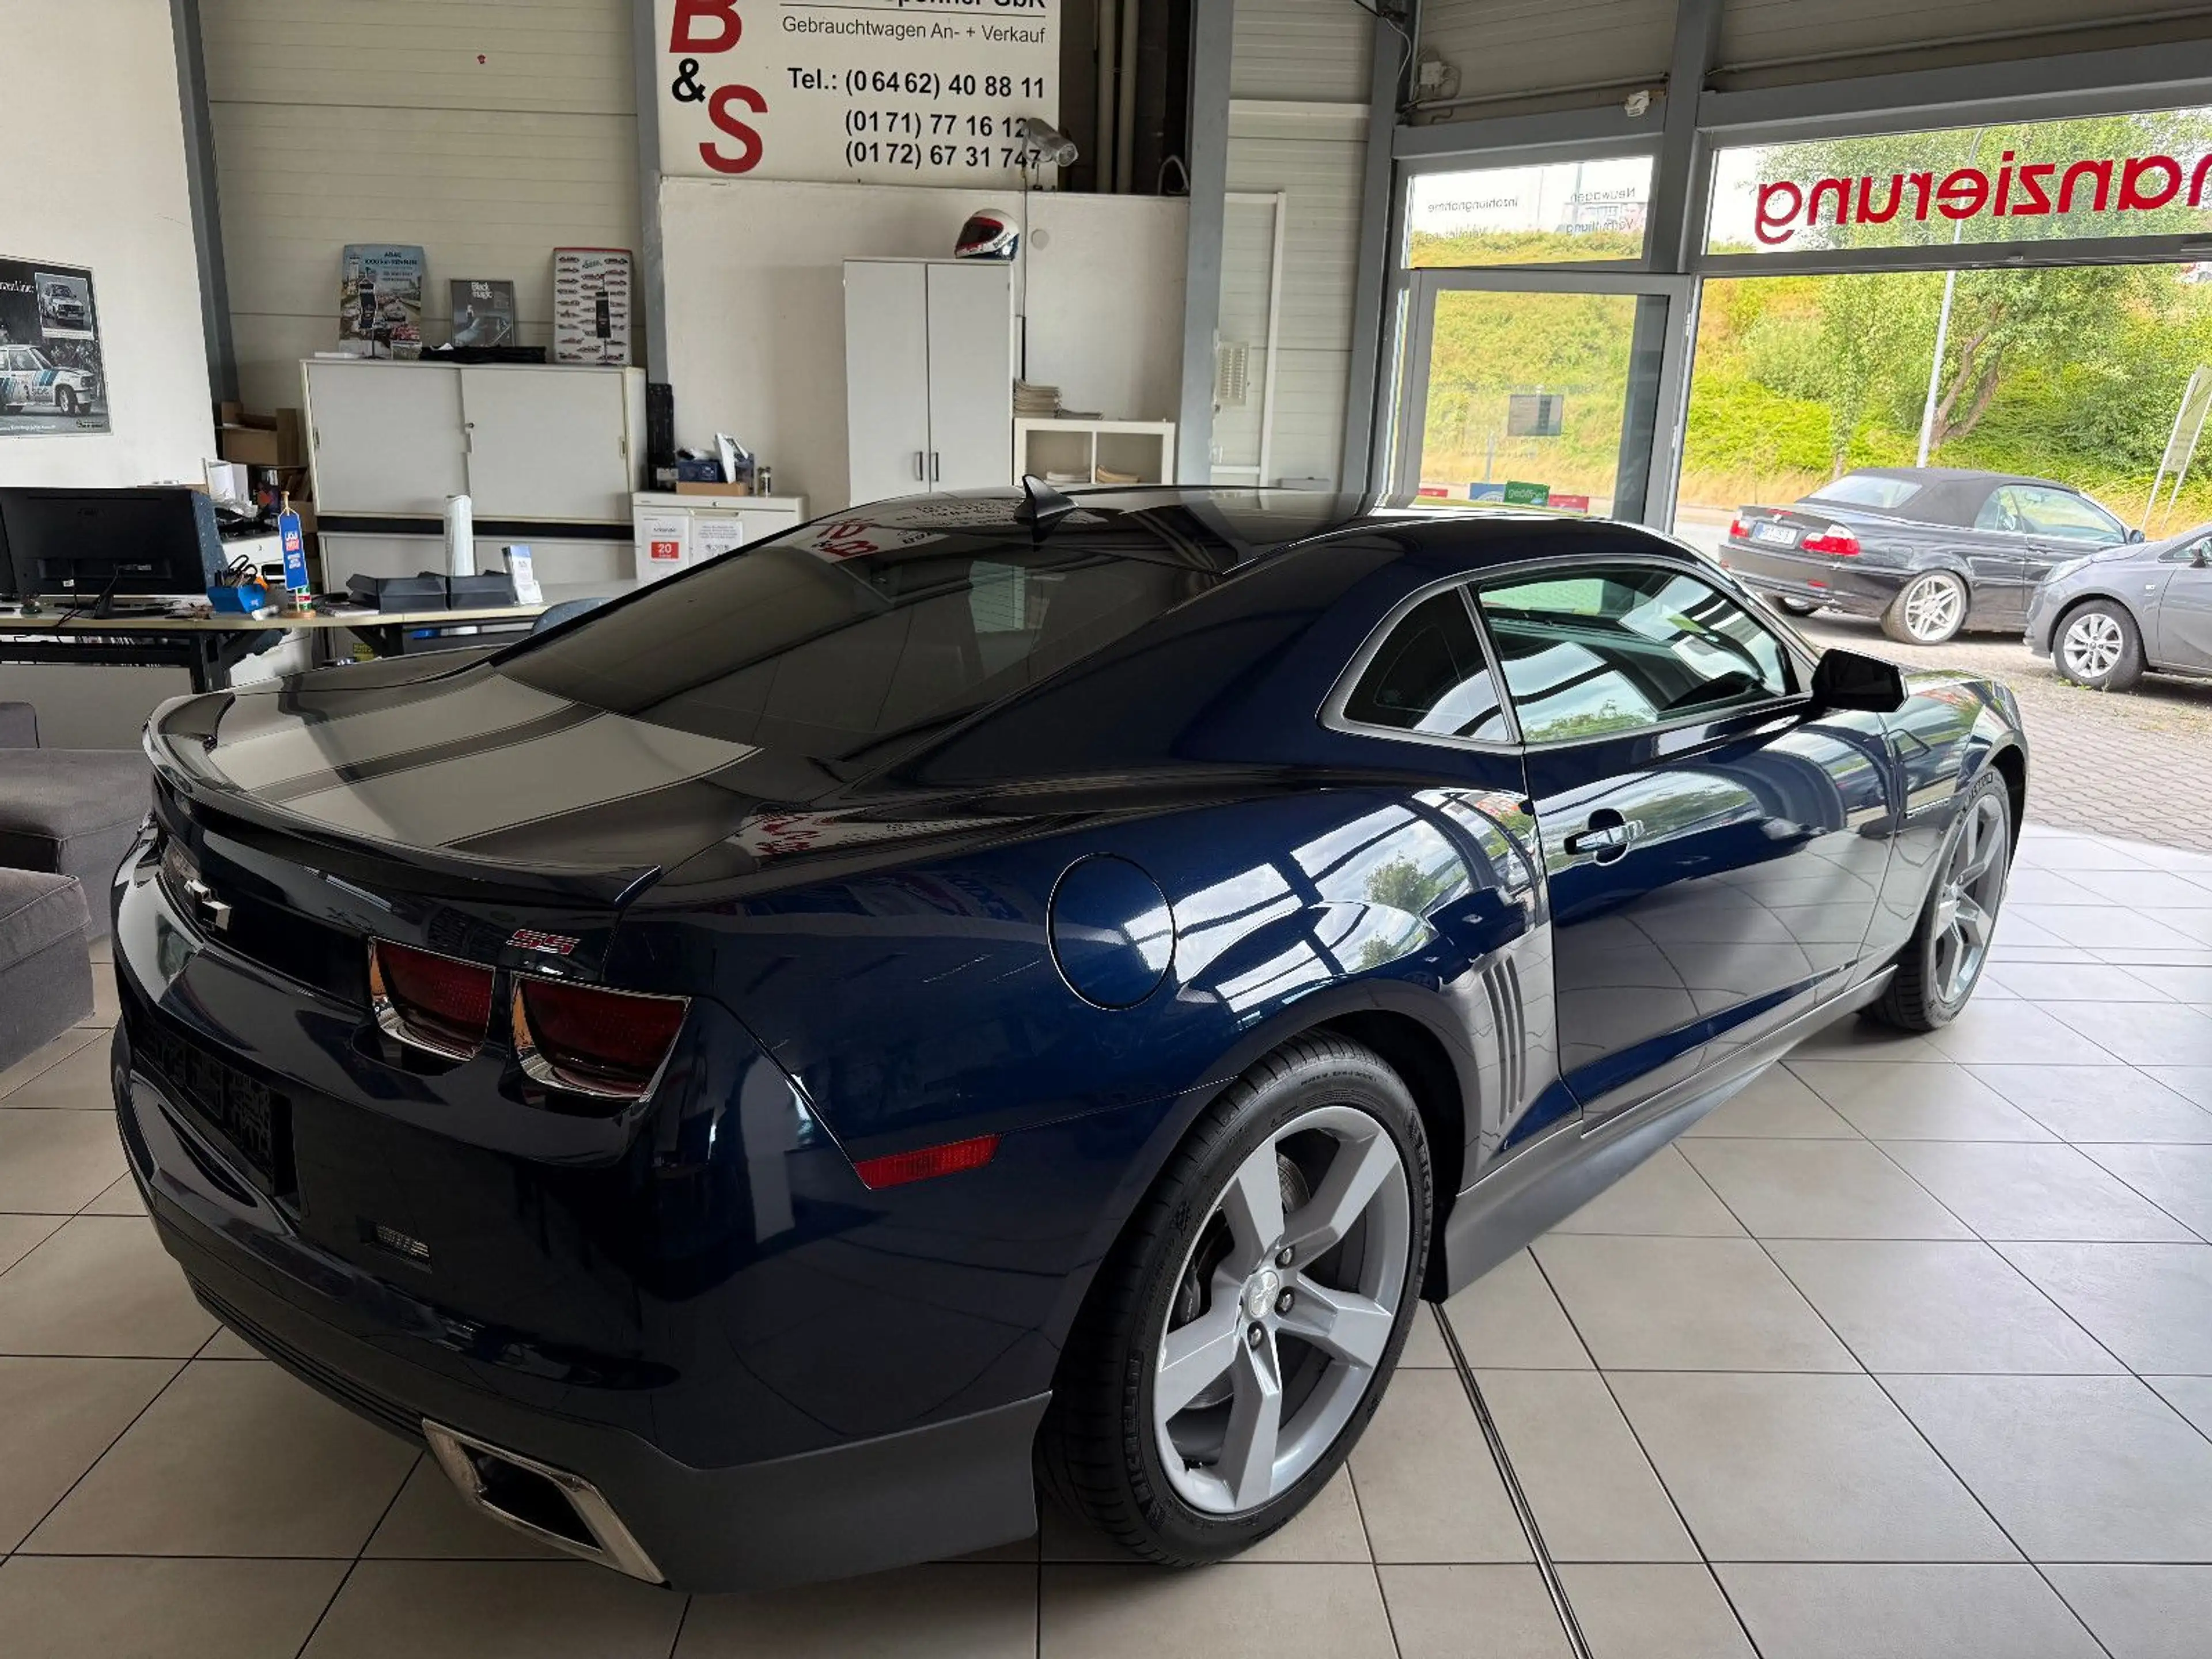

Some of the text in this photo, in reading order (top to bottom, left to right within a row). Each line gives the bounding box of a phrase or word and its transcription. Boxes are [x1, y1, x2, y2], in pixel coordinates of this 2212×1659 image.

[670, 0, 741, 53] B
[782, 16, 926, 41] Gebrauchtwagen
[931, 22, 960, 39] An-
[981, 25, 1046, 44] Verkauf
[672, 58, 706, 103] &
[787, 67, 837, 90] Tel.:
[948, 74, 976, 96] 40
[985, 75, 1012, 97] 88
[1021, 77, 1043, 98] 11
[699, 85, 768, 173] S
[930, 113, 957, 135] 77
[966, 115, 993, 137] 16
[930, 145, 957, 165] 67
[965, 146, 990, 167] 31
